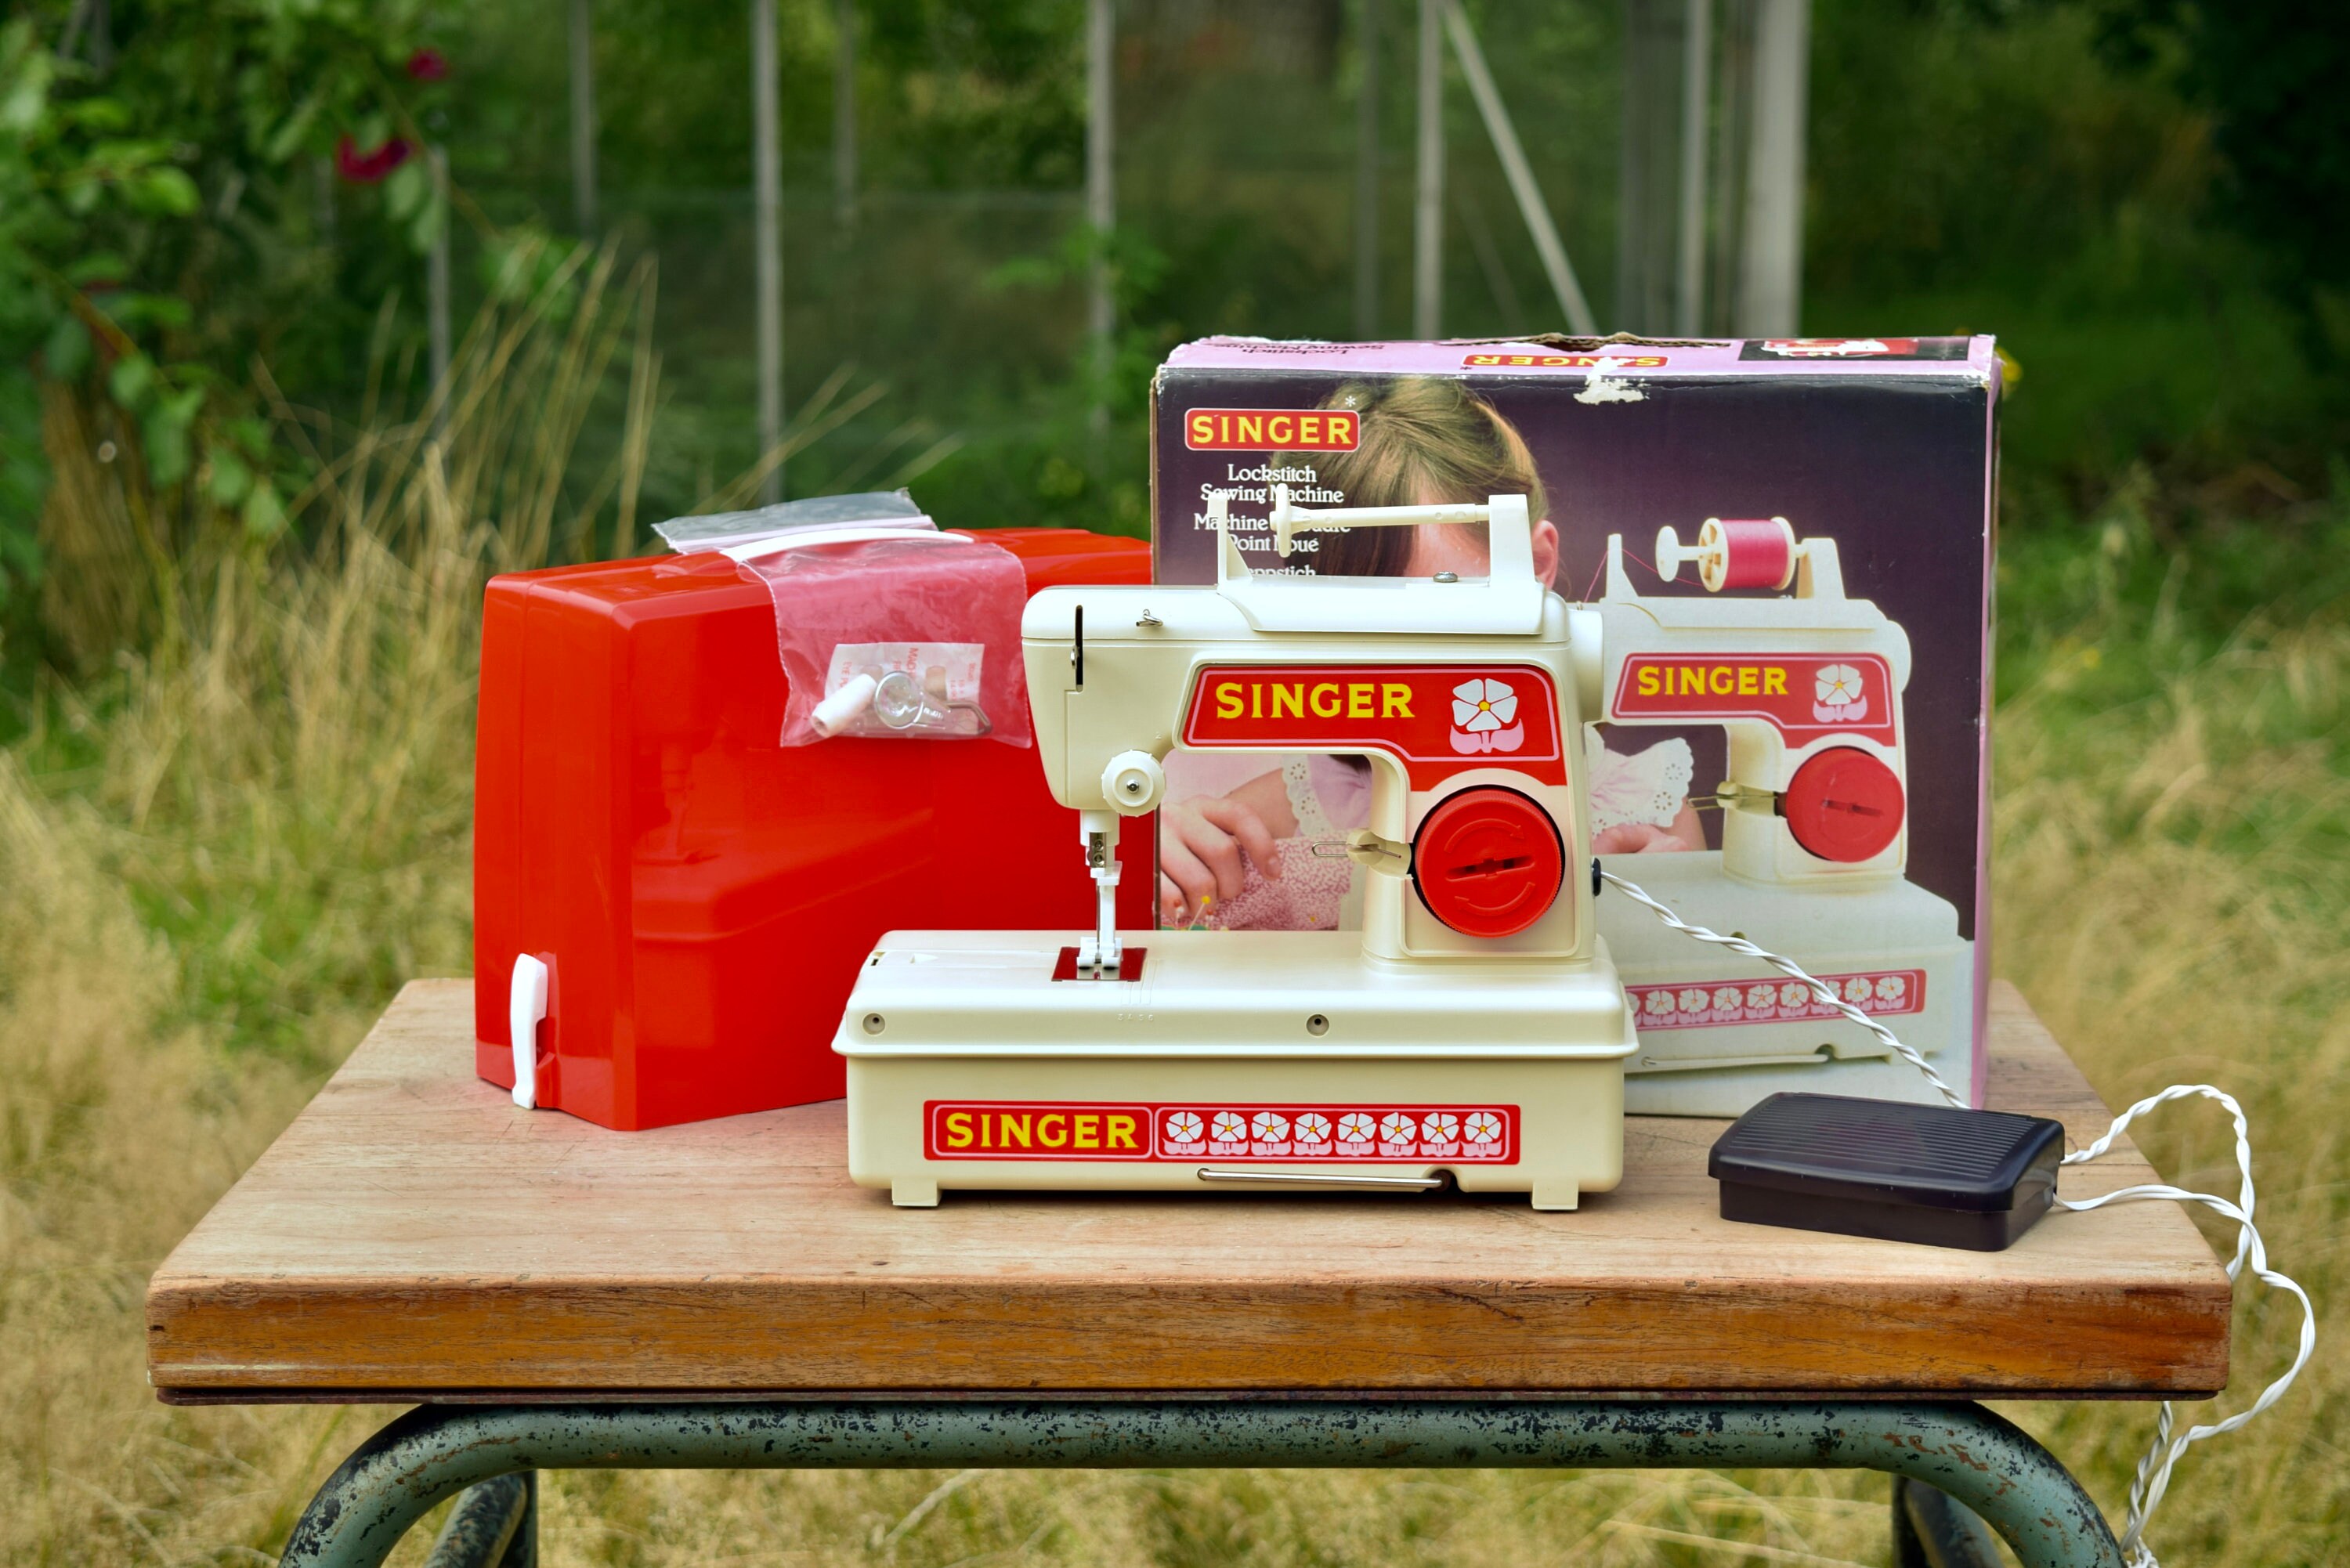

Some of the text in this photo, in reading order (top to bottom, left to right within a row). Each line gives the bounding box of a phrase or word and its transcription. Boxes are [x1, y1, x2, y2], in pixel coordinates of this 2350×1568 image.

[1473, 356, 1660, 367] SNGER
[1192, 416, 1351, 444] SINGER
[1227, 464, 1317, 482] Lockstitch
[1194, 512, 1268, 531] Mahine
[1638, 666, 1788, 695] SINGER
[1216, 682, 1415, 719] SINGER
[946, 1113, 1138, 1149] SINGER
